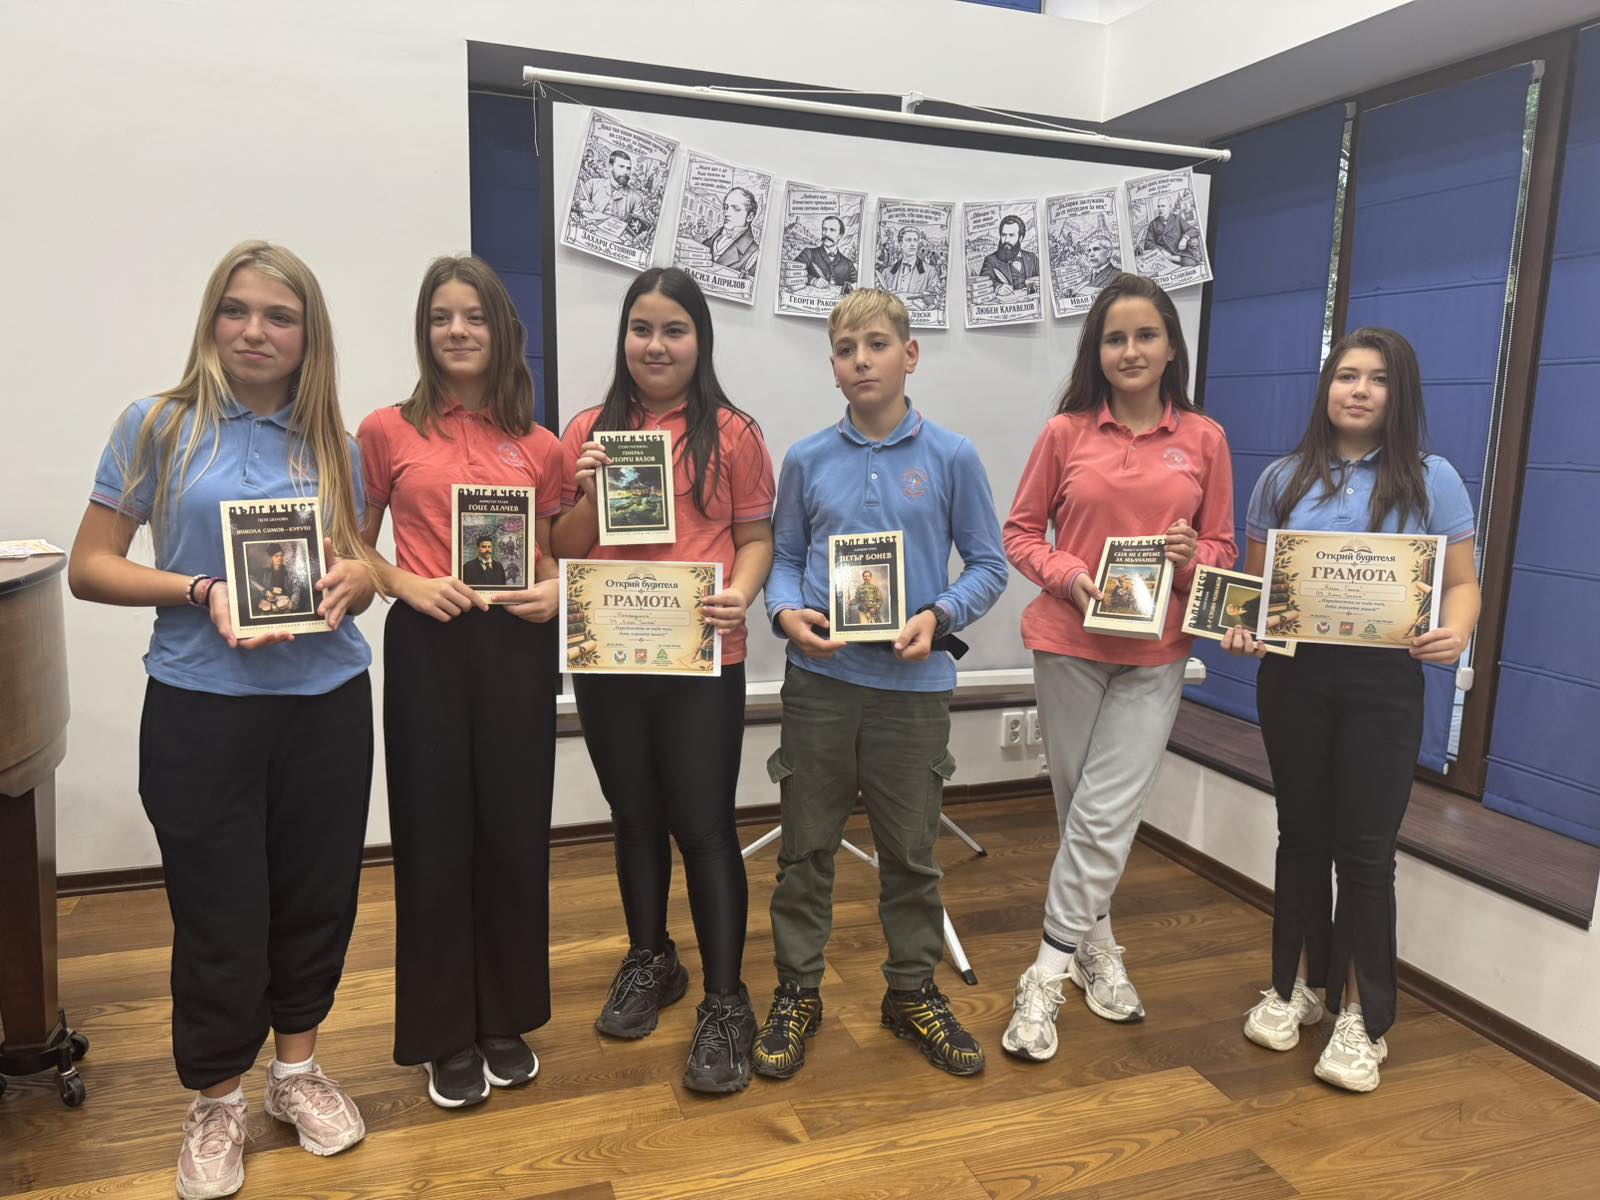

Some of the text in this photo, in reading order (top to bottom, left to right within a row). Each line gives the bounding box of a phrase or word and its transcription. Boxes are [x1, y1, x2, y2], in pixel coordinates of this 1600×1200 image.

[711, 275, 746, 290] АПРИЛОВ
[789, 295, 815, 306] ГЕОРГИ
[639, 434, 664, 442] ЧЕСТ
[500, 489, 529, 498] ЧЕСТ
[228, 502, 315, 515] ДЪЛГ И ЧЕСТ
[871, 535, 897, 544] ЧЕСТ
[865, 552, 893, 561] БОНЕВ
[1316, 550, 1396, 563] Открий будителя
[1311, 566, 1397, 582] ГРАМОТА
[605, 579, 679, 590] Открий будителя
[603, 594, 681, 608] ГРАМОТА
